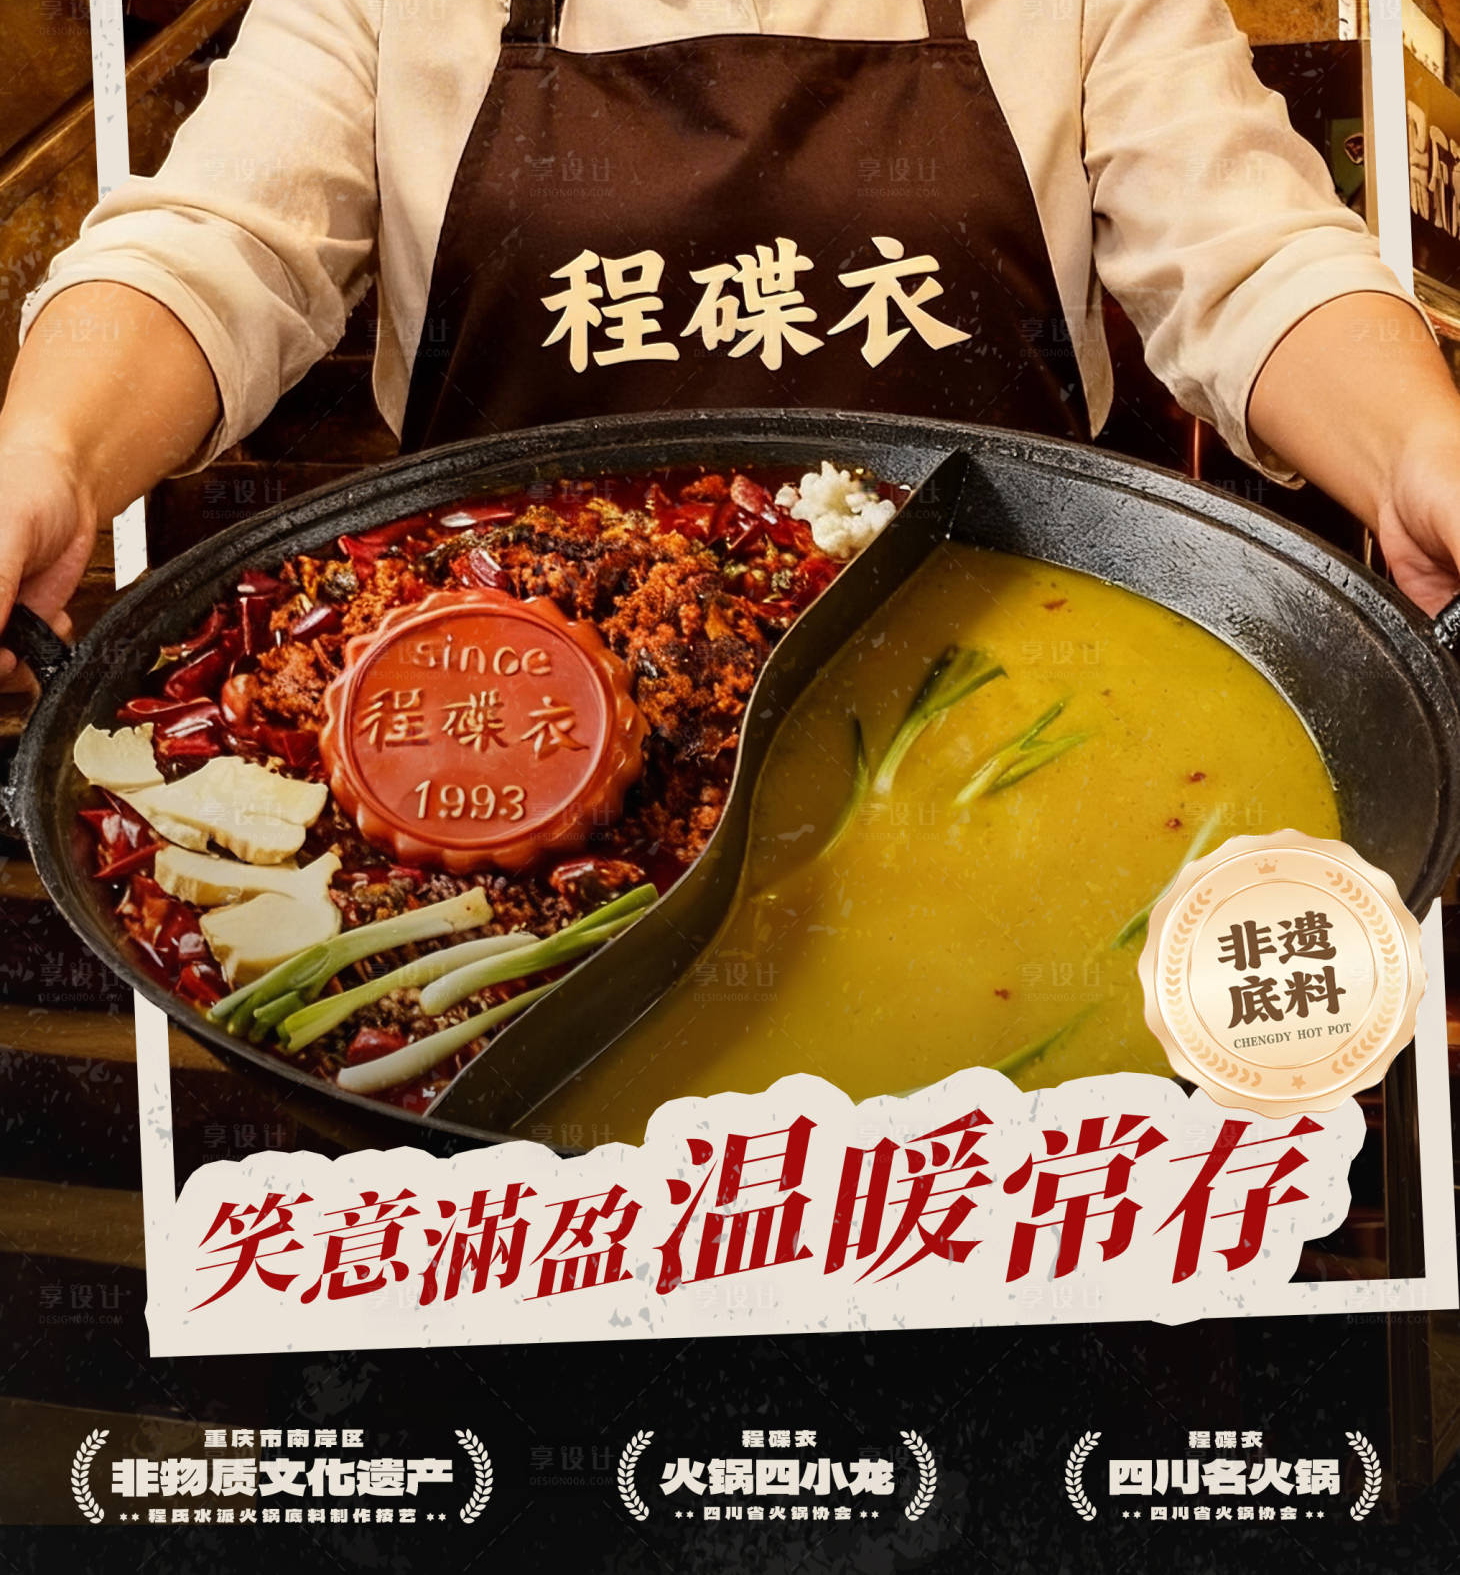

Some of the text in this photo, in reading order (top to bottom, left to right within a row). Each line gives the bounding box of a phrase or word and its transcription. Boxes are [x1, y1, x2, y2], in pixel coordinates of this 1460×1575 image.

[540, 235, 972, 374] 程碟衣
[413, 779, 528, 822] 1993
[1217, 910, 1337, 972] 非遗
[1227, 965, 1347, 1030] 底料
[1233, 1022, 1352, 1049] CHENGDY HOT POT
[188, 1108, 1325, 1313] 笑意滿盈 温暖常存
[203, 1428, 364, 1448] 重庆市南岸区
[741, 1429, 817, 1448] 程碟衣
[1188, 1430, 1263, 1449] 程碟衣
[111, 1457, 454, 1498] 非物质文化遗产
[659, 1457, 895, 1496] 火锅四小龙
[1109, 1457, 1341, 1496] 四川名火锅
[703, 1505, 852, 1521] 四川省火锅协会
[1150, 1505, 1298, 1521] 四川省火锅协会
